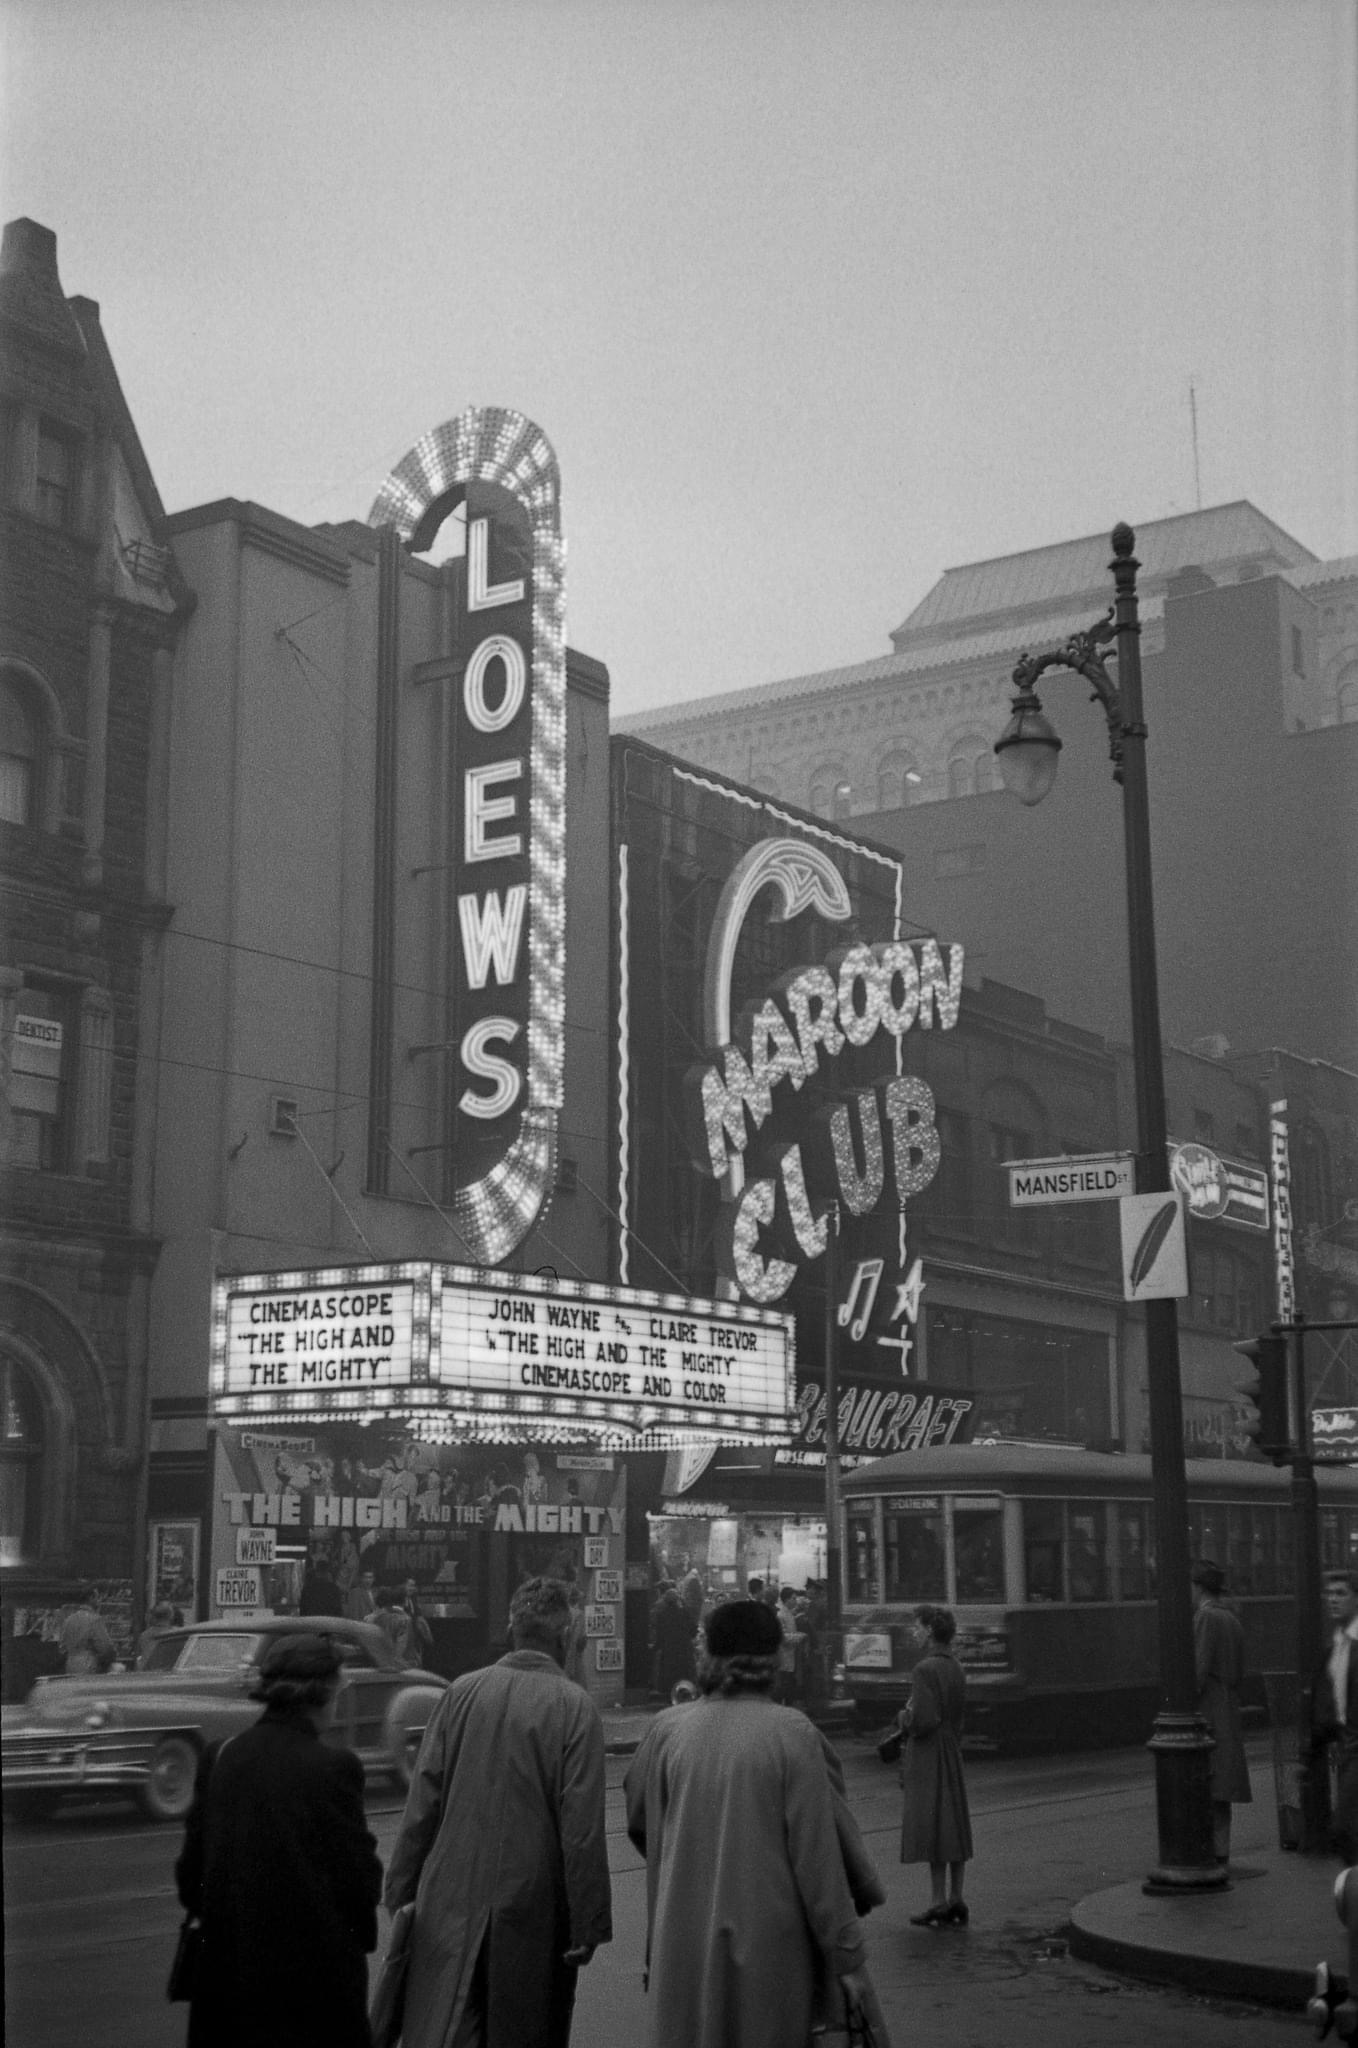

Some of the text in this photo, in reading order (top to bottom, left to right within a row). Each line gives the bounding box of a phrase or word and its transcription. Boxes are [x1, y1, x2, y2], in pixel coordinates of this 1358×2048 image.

[18, 1020, 59, 1041] DENTIST
[698, 938, 965, 1180] MAROON
[731, 1074, 941, 1304] CLUB
[1016, 1170, 1117, 1196] MANSFIELD
[250, 1293, 393, 1324] CINEMASCOPE
[488, 1298, 758, 1352] JOHN WAYNE AND CLAIRE TREVOR
[295, 1328, 344, 1352] HIGH
[350, 1325, 395, 1348] AND
[546, 1333, 586, 1359] HIGH
[596, 1342, 628, 1364] AND
[639, 1346, 667, 1368] THE
[250, 1363, 288, 1385] THE
[521, 1364, 727, 1404] CINEMASCOPE AND COLOR
[799, 1383, 973, 1450] BEAUCRAFT
[222, 1492, 301, 1525] THE
[314, 1496, 408, 1529] HIGH
[416, 1504, 452, 1523] AND
[454, 1505, 485, 1524] THE
[494, 1503, 625, 1535] MIGHTY
[241, 1540, 273, 1561] WAYNE
[219, 1580, 257, 1603] TREVOR
